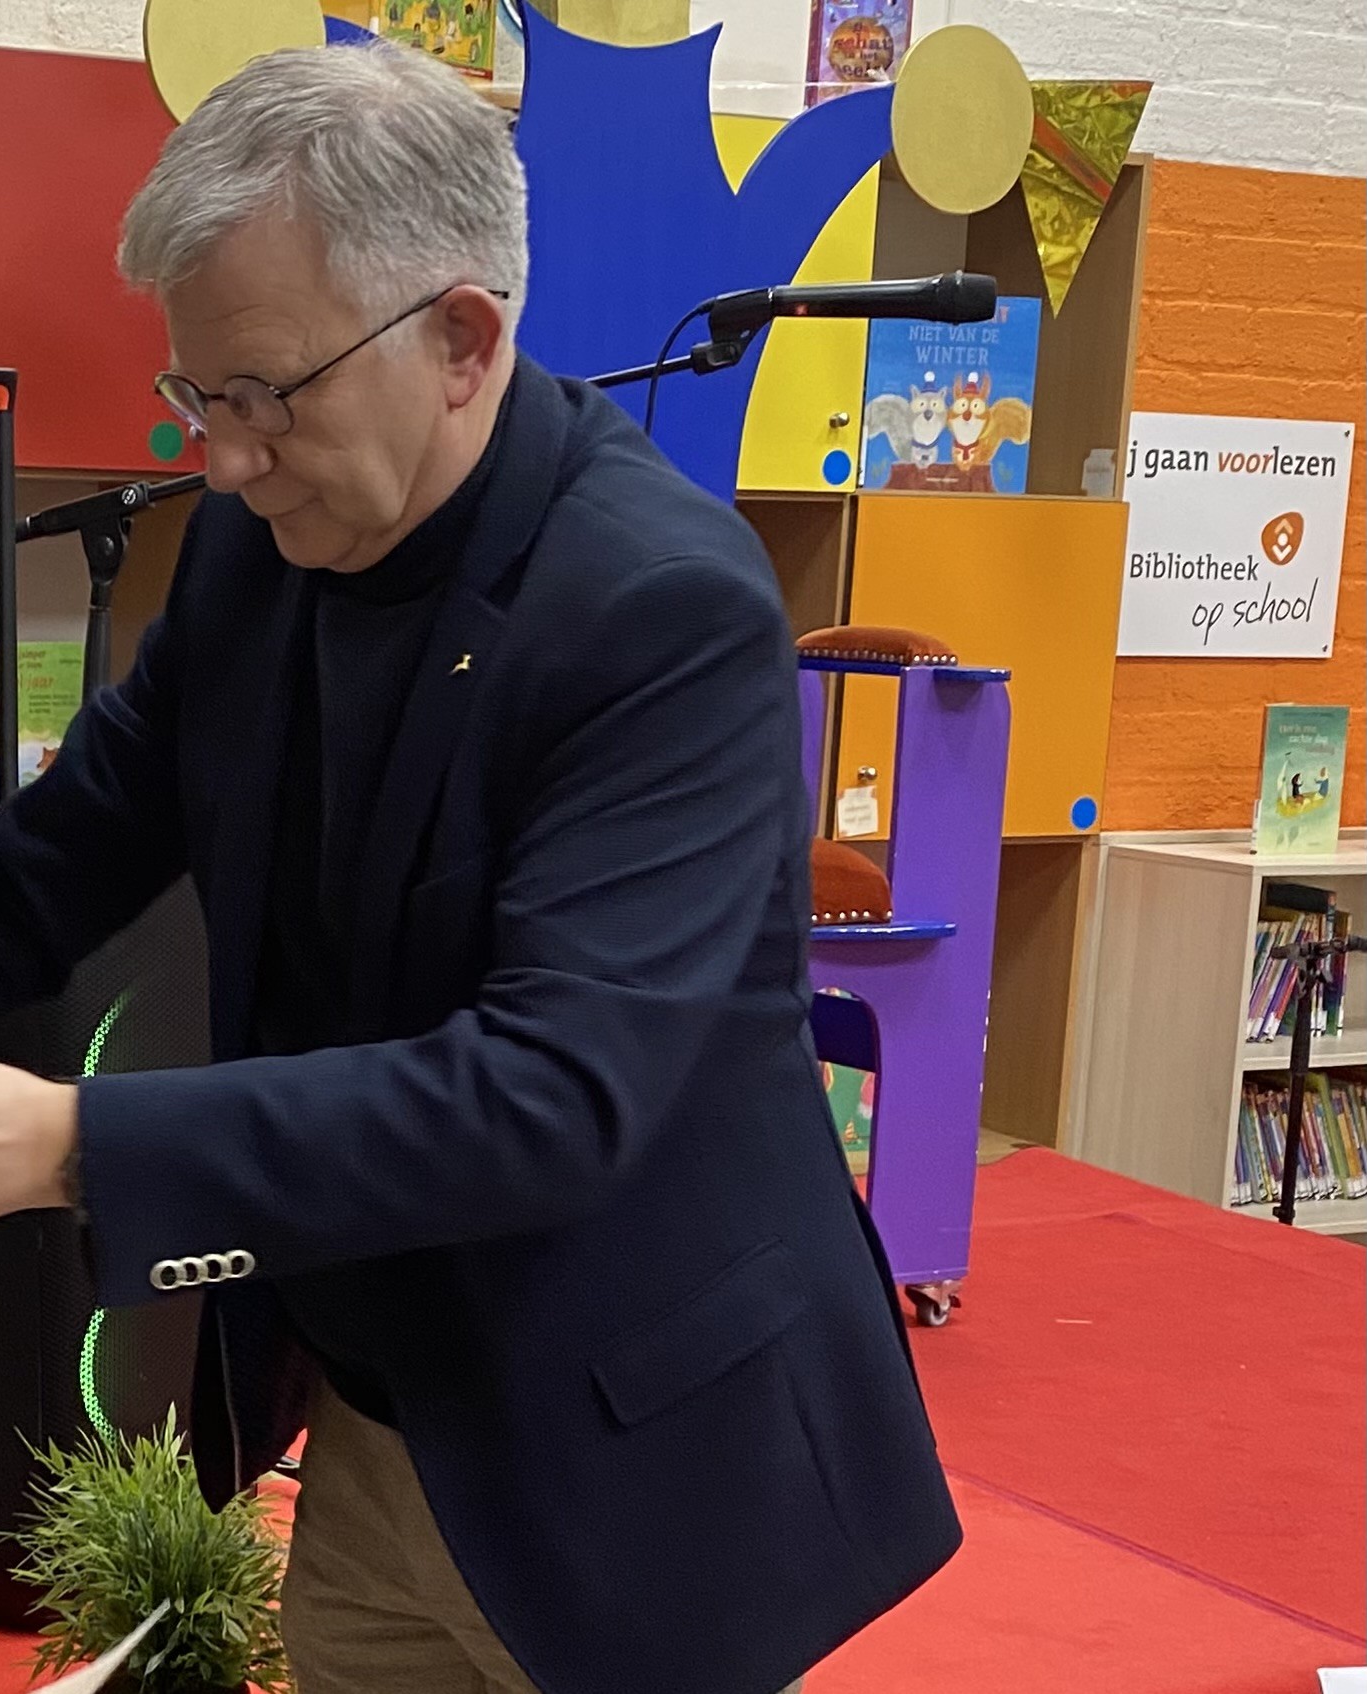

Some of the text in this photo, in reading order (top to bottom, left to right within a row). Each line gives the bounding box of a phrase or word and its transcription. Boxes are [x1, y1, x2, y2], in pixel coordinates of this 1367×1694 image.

[908, 325, 1000, 344] NIET VAN DE
[915, 346, 989, 366] WINTER
[1127, 440, 1336, 478] j gaan voorlezen
[1130, 552, 1260, 581] Bibliotheek
[1192, 577, 1319, 646] op school
